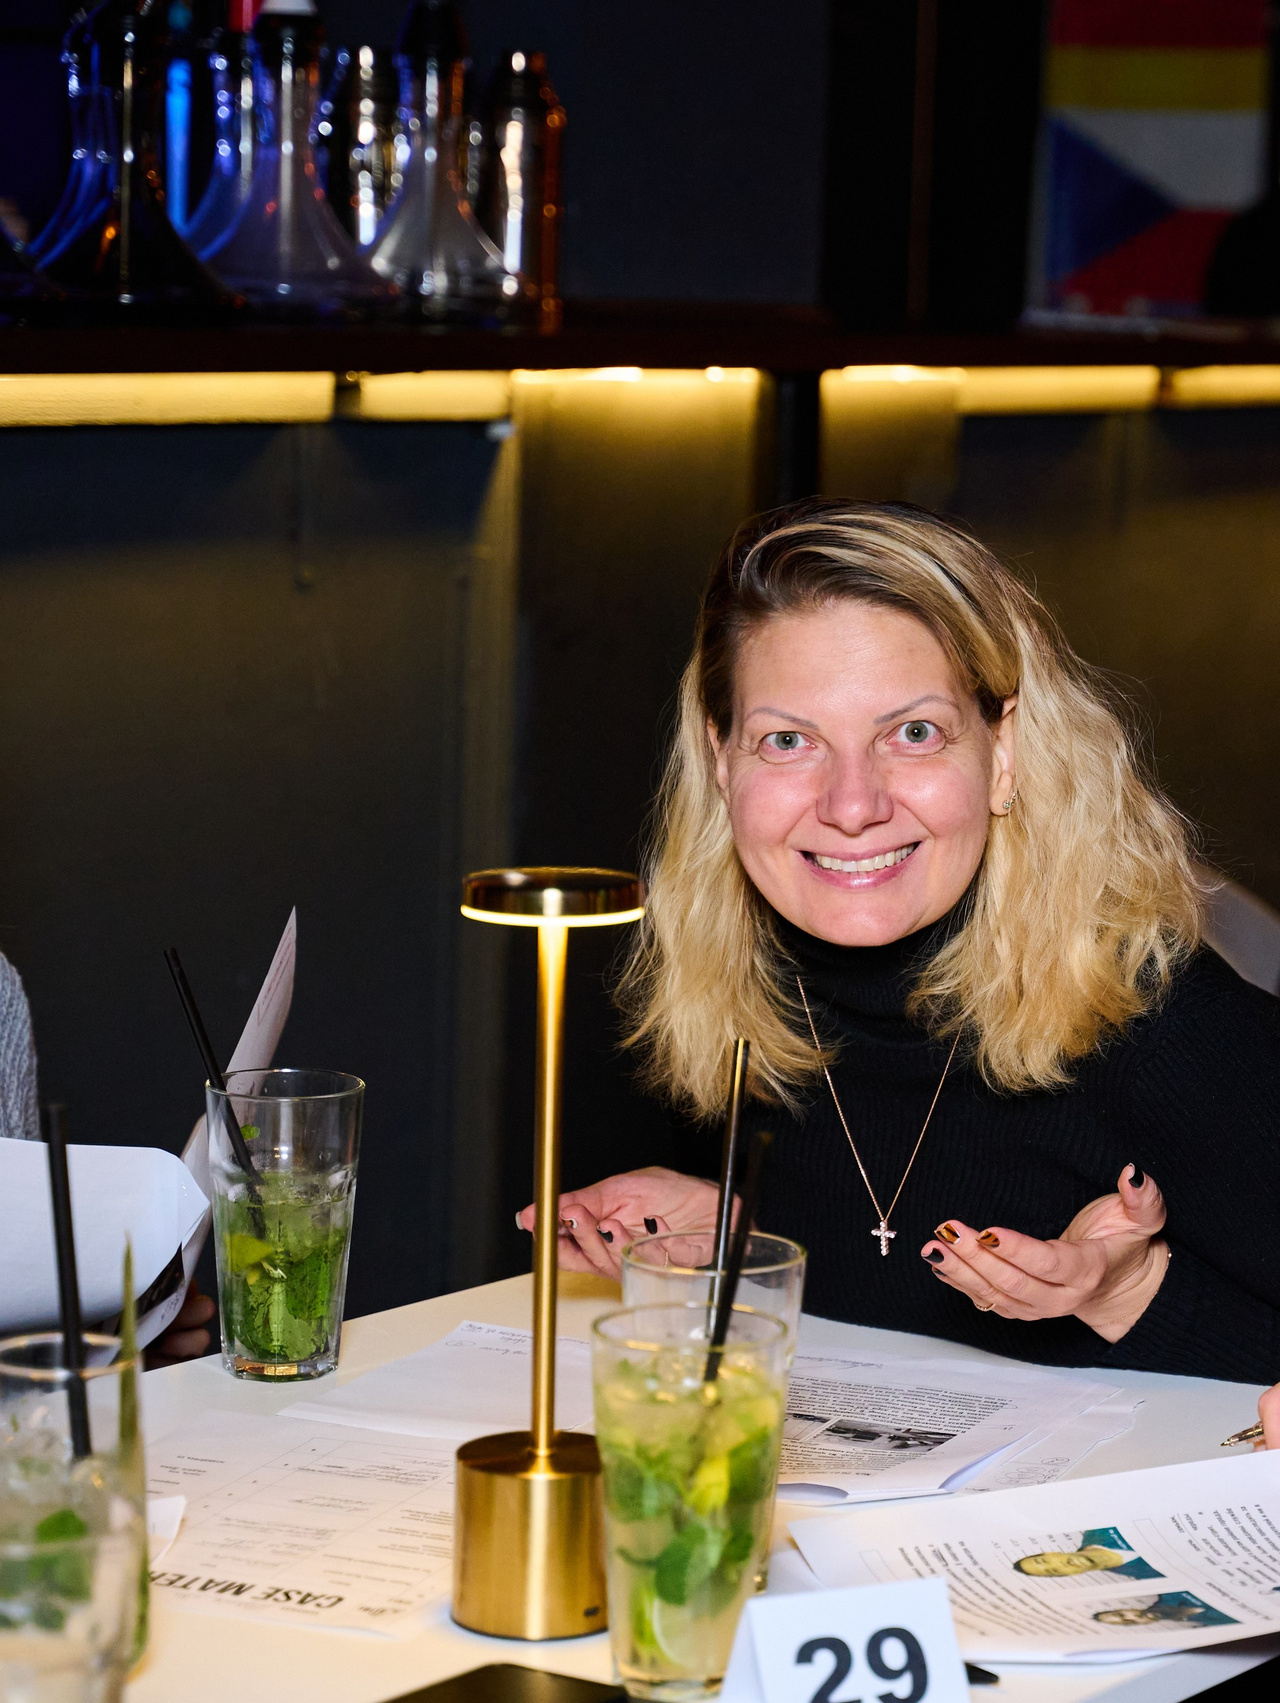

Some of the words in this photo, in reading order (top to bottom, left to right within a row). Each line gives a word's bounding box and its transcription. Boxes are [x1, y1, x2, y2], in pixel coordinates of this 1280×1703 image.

[1224, 1508, 1242, 1524] службе
[251, 1586, 344, 1609] CASE
[795, 1627, 928, 1703] 29
